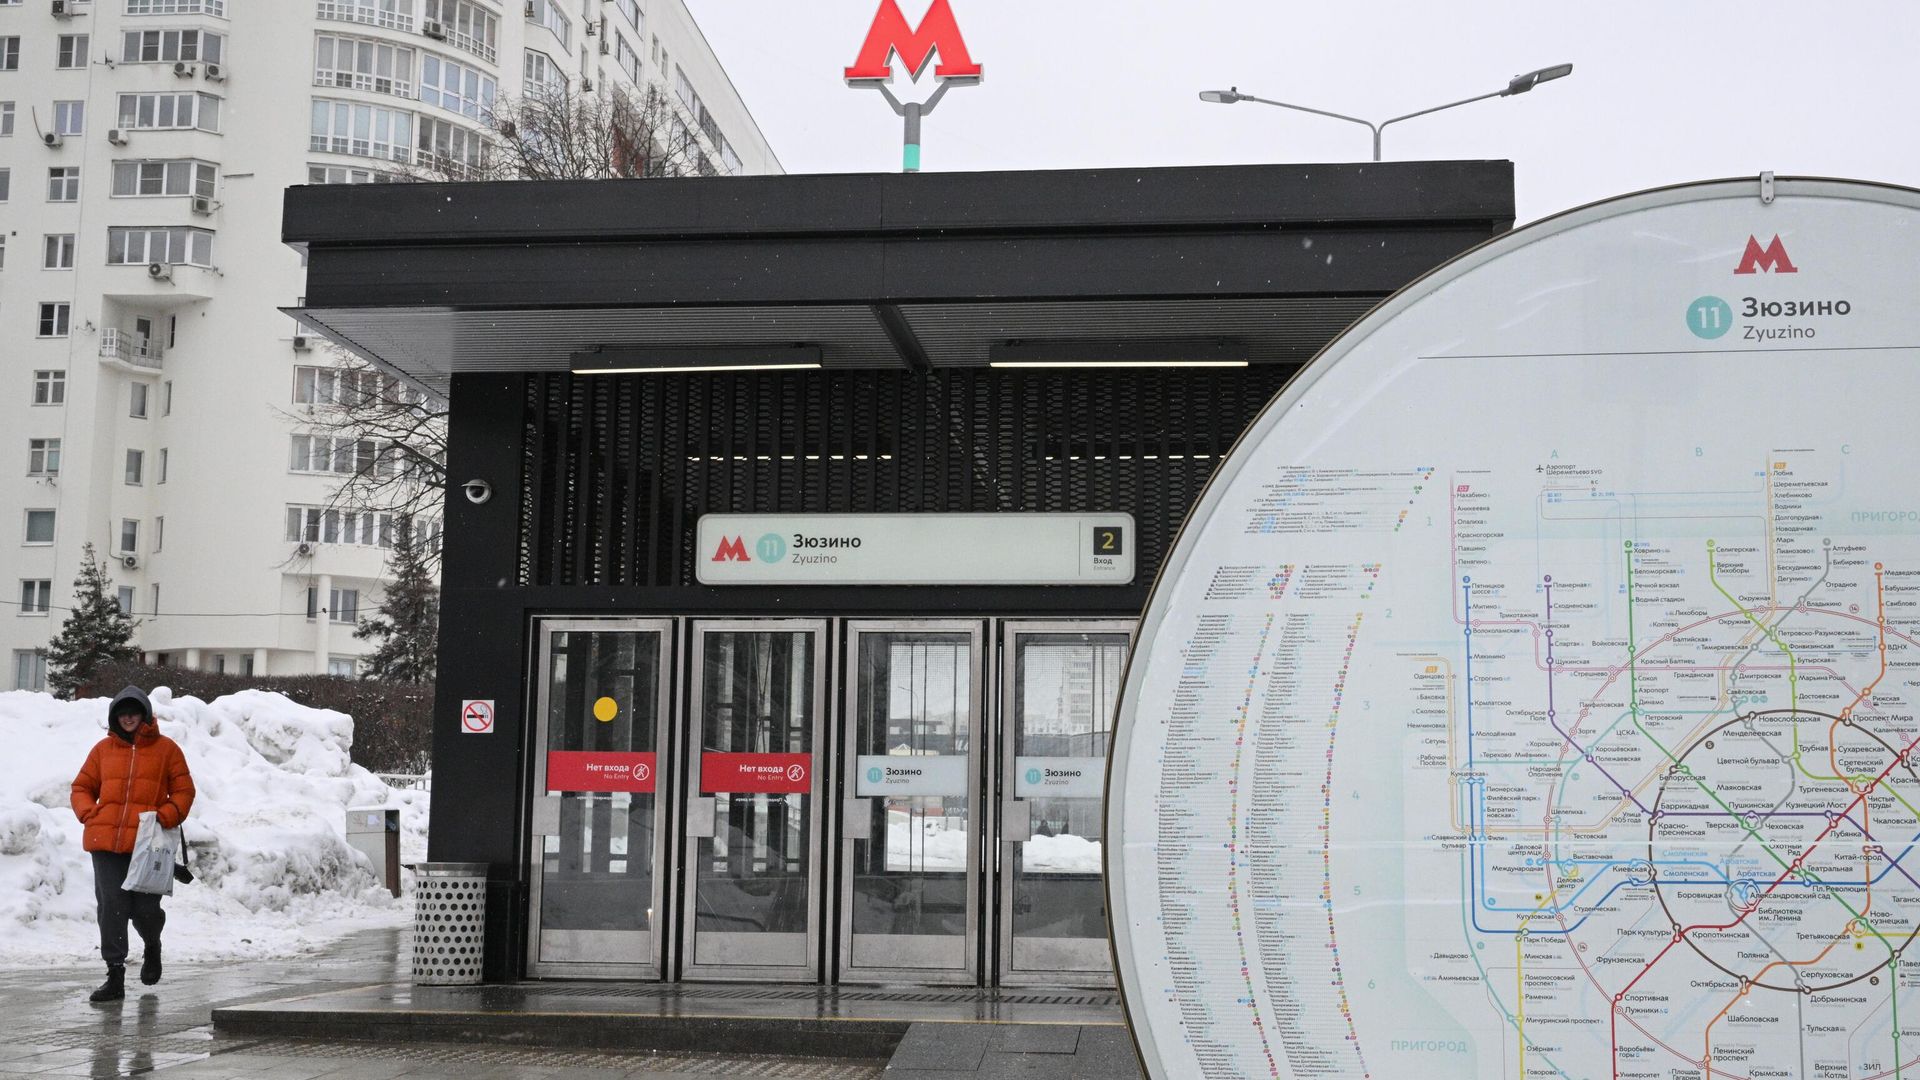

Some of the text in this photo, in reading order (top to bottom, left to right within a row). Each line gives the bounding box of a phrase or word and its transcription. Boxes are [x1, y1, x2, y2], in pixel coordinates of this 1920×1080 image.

[1698, 297, 1850, 328] 11 Зюзино
[1743, 326, 1815, 342] Zyuzino
[1851, 511, 1920, 522] ПРИГОРО
[764, 540, 778, 557] 11
[793, 534, 861, 549] Зюзино
[1102, 532, 1114, 549] 2
[792, 554, 837, 565] Zyuzino
[1094, 557, 1112, 565] Вход
[1750, 757, 1780, 765] бульвар
[886, 768, 922, 776] Зюзино
[1045, 769, 1081, 777] Зюзино
[1391, 1040, 1467, 1053] ПРИГОРОД
